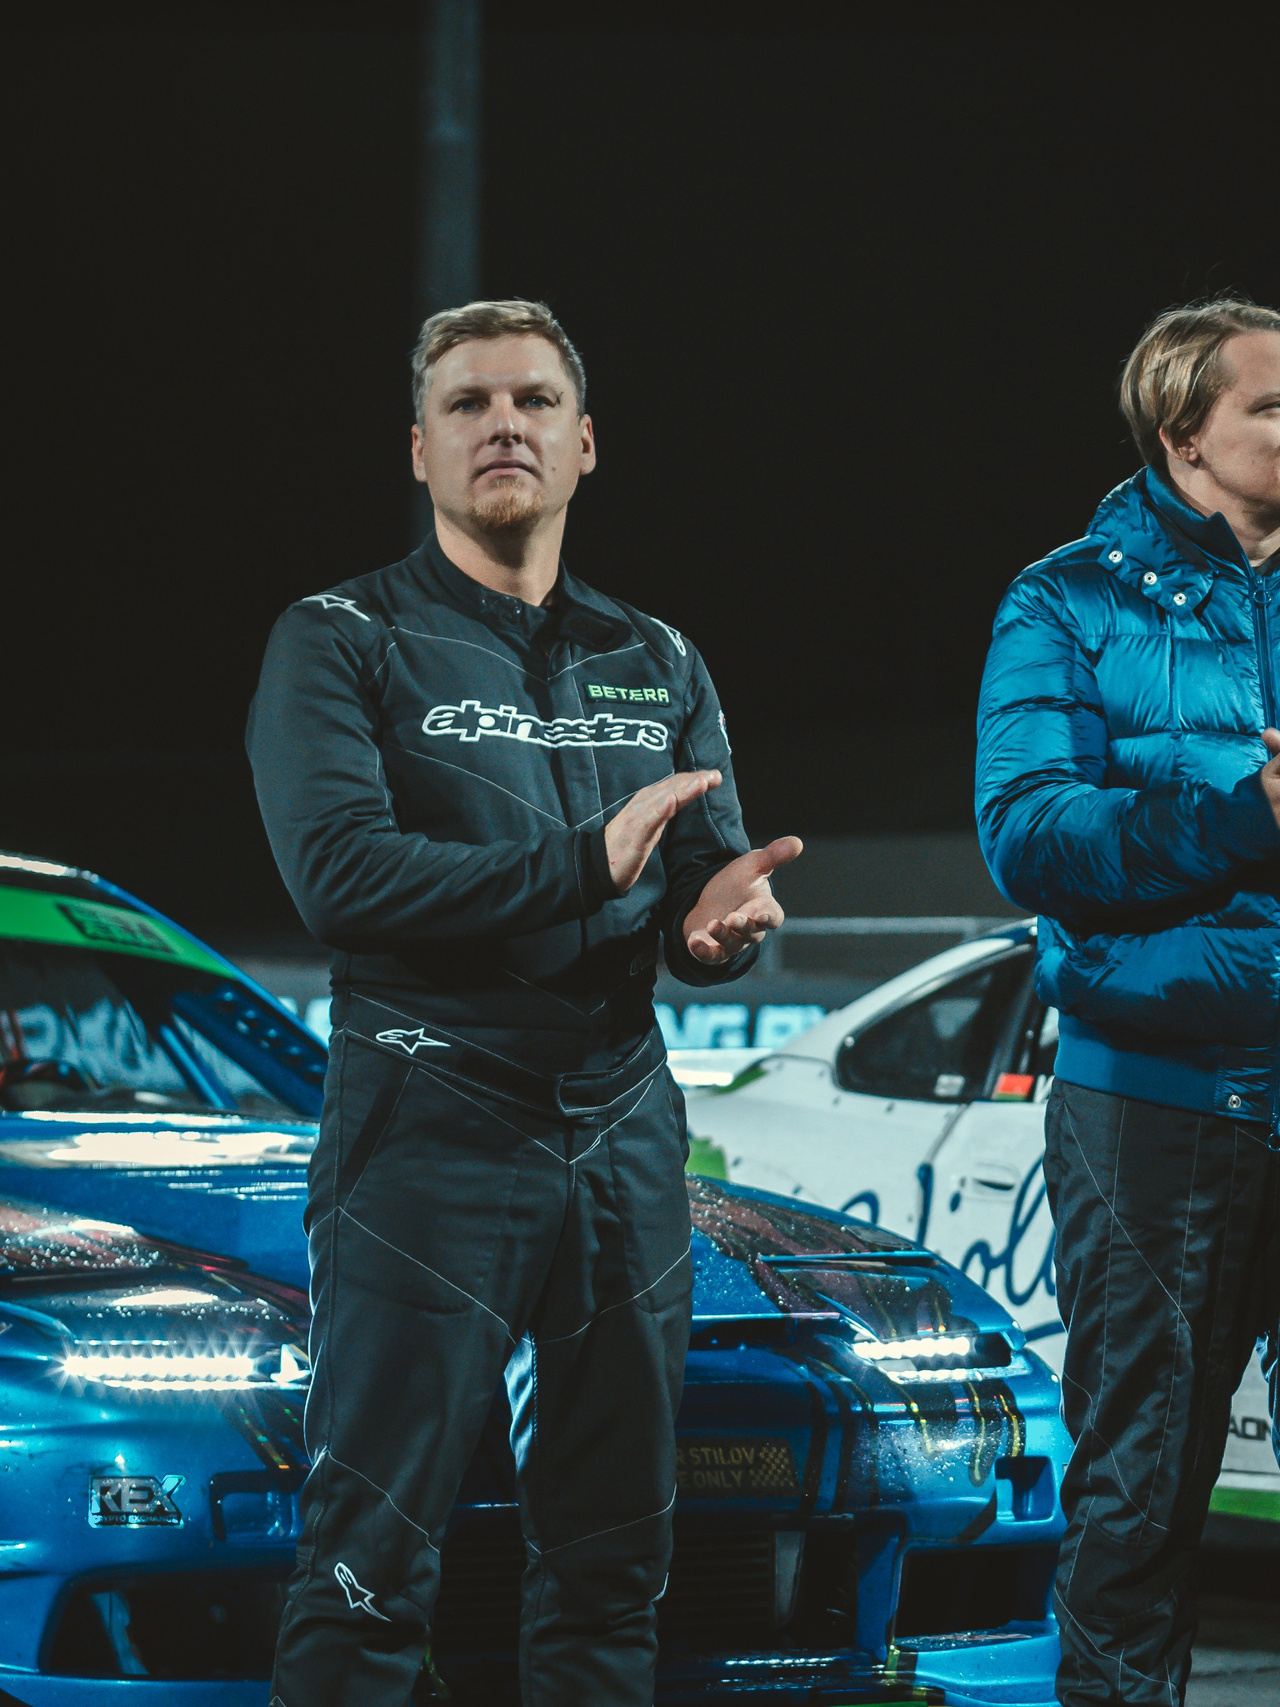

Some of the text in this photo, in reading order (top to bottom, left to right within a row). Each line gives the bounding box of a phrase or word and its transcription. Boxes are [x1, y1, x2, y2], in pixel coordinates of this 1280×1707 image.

[588, 684, 669, 703] BETERA
[422, 700, 668, 751] alpinestars
[694, 1469, 743, 1489] ONLY
[91, 1476, 183, 1513] REX
